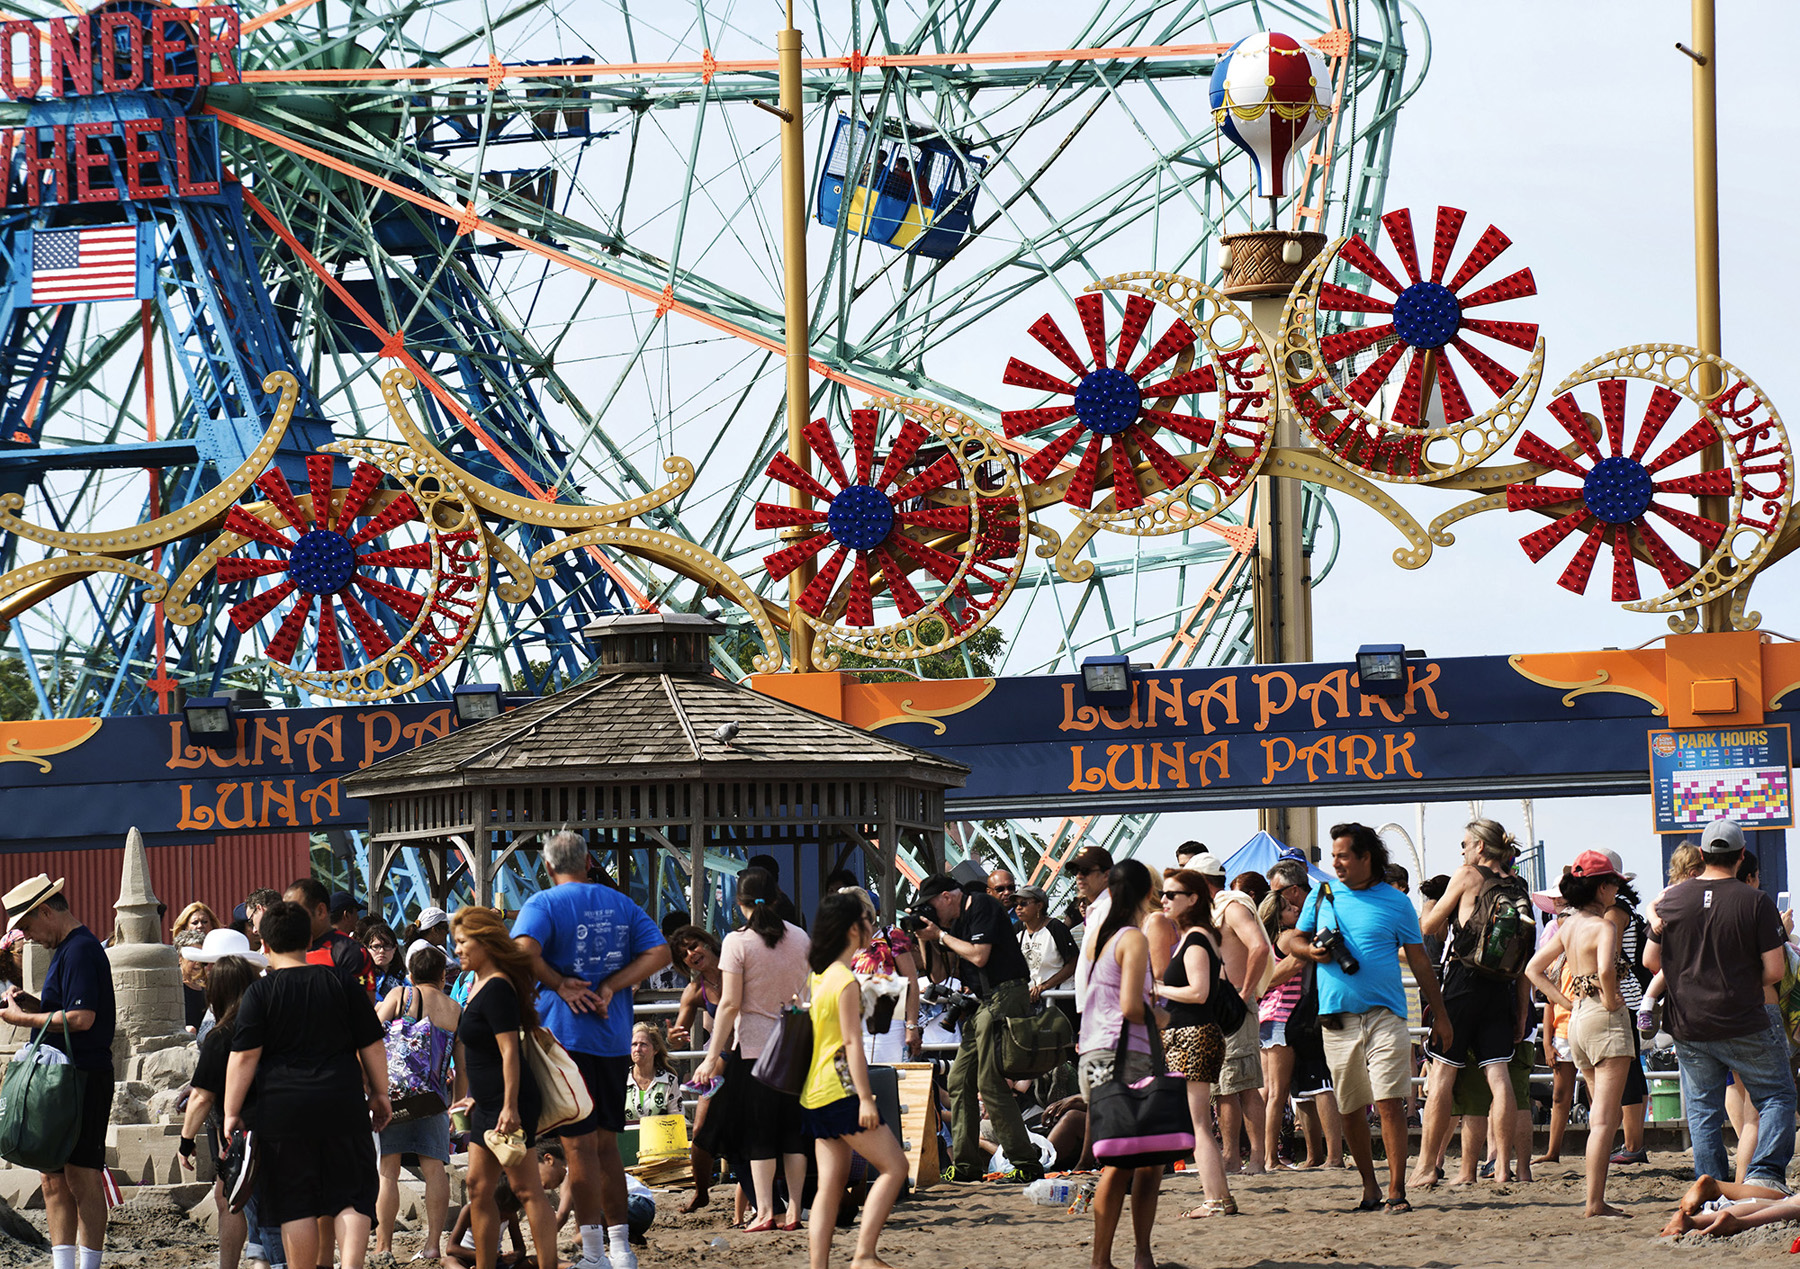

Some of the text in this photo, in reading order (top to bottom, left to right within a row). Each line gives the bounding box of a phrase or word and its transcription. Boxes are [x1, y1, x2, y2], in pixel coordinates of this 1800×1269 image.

[0, 5, 240, 101] ONDER
[0, 116, 220, 208] HEEL
[1200, 343, 1270, 498] LUNA
[1289, 373, 1425, 477] LUNA
[1707, 379, 1787, 534] LUNA
[402, 528, 481, 674] LUNA
[935, 494, 1020, 637] LUNA
[166, 714, 344, 772] LUNA
[1058, 676, 1240, 735] LUNA
[1678, 733, 1718, 749] PARK
[1720, 730, 1769, 747] HOURS
[176, 777, 341, 831] LUNA
[1067, 732, 1423, 792] LUNA PARK
